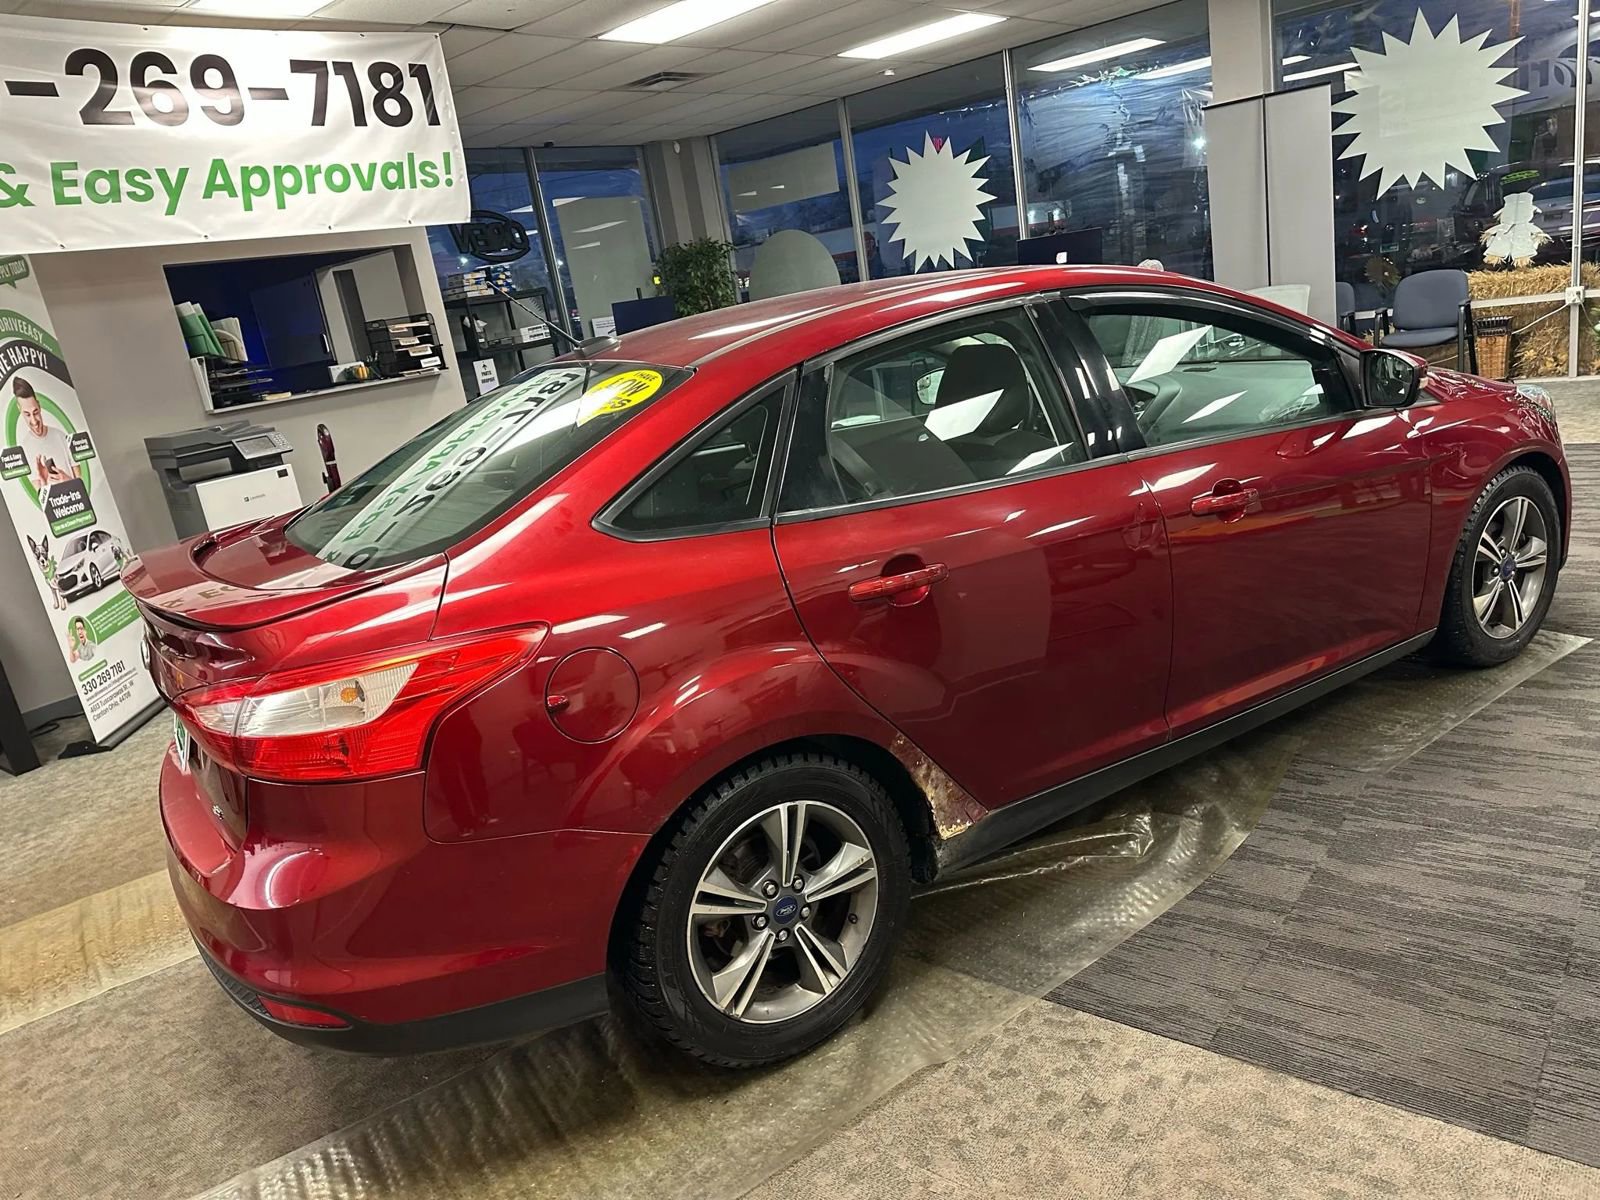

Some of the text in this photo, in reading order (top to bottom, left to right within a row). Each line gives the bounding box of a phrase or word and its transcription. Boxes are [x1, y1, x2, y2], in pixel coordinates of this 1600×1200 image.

[4, 48, 442, 127] -269-7181
[0, 151, 454, 216] & Easy Approvals!
[6, 345, 48, 370] HAPPY!
[49, 491, 81, 508] Trade-Ins
[53, 502, 85, 519] Welcome
[81, 678, 98, 695] 330
[96, 669, 112, 687] 269
[109, 660, 126, 677] 7181
